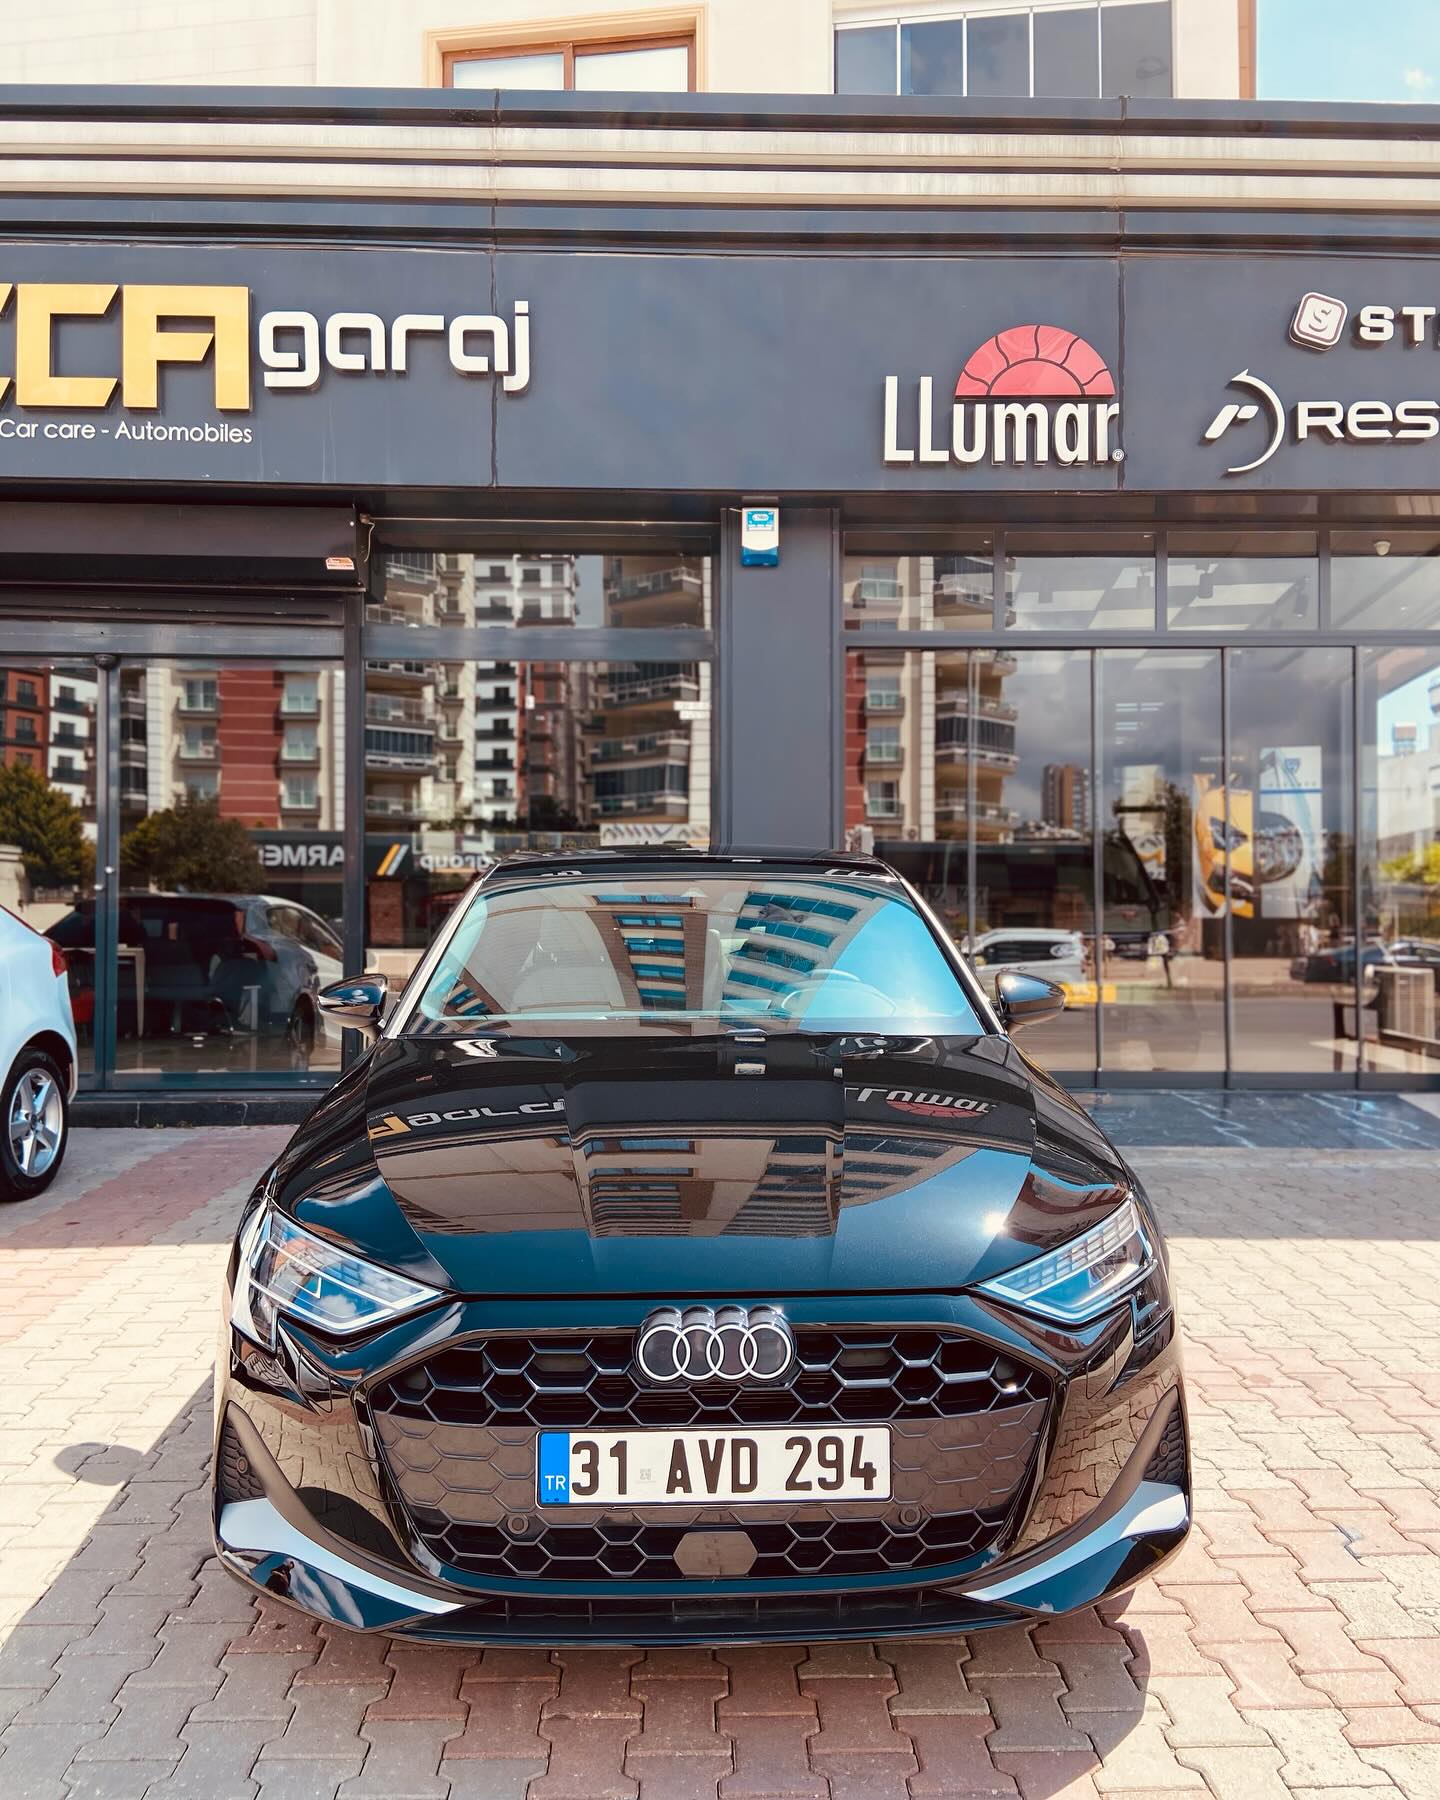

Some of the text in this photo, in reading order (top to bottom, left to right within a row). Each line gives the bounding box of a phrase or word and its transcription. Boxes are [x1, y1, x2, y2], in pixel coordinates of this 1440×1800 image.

[1360, 306, 1440, 342] ST
[0, 283, 530, 410] CA garaj
[0, 419, 38, 439] Car
[44, 422, 96, 439] care
[115, 420, 253, 443] Automobiles
[545, 1475, 566, 1491] TR
[572, 1435, 877, 1495] 31 AVD 294
